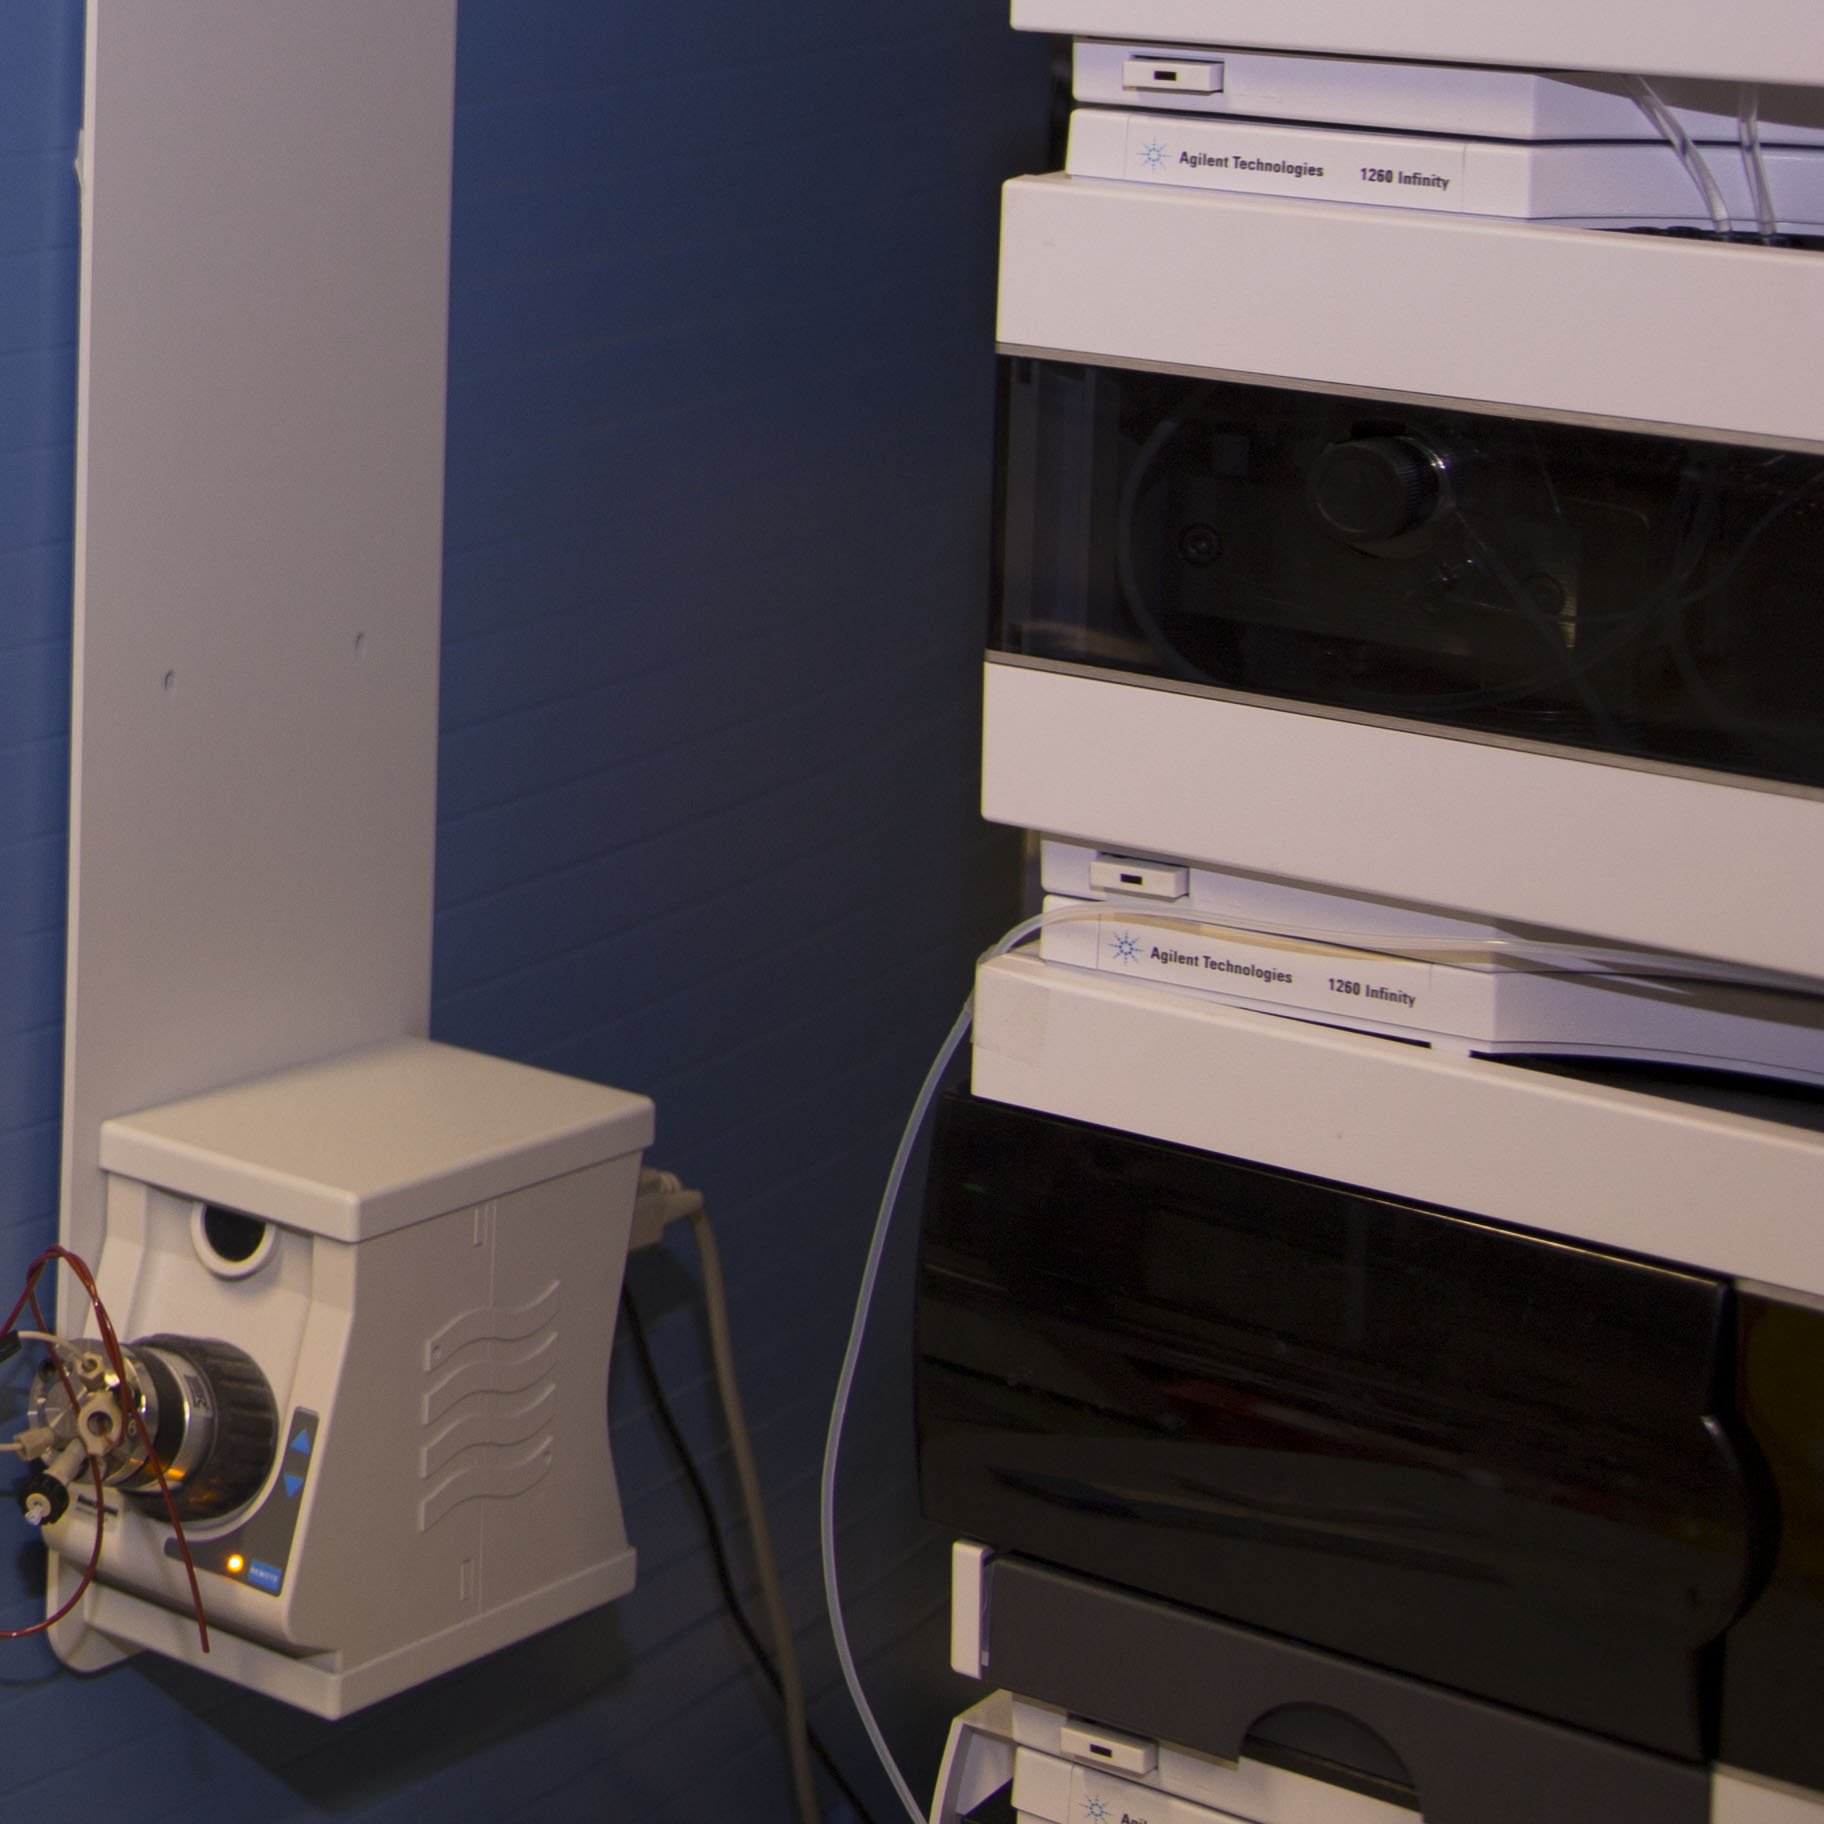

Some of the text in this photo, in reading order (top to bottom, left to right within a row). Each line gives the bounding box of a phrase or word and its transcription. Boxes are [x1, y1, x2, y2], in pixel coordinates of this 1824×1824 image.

[1179, 151, 1450, 191] Agilent Technologies 1260 Infinity
[1151, 946, 1417, 1009] Agilent Technologies 1260 Infinity
